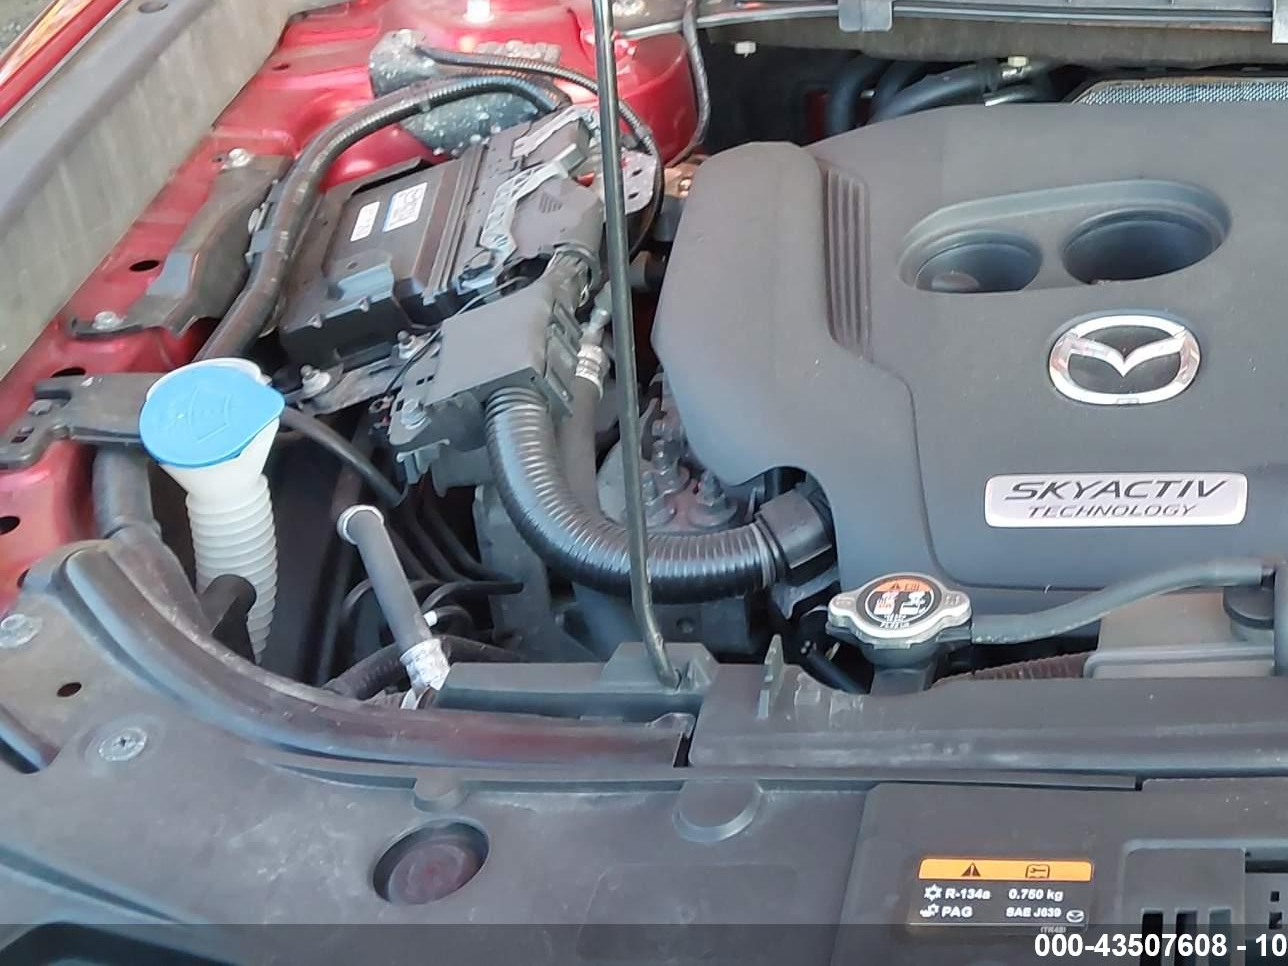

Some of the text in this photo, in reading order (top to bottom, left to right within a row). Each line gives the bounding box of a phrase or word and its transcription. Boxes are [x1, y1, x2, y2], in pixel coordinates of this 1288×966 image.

[1004, 480, 1228, 500] SKYACTIV
[1027, 504, 1197, 518] TECHNOLOGY
[945, 888, 1063, 902] R-134a 0.750 kg
[941, 906, 973, 918] PAG
[1006, 907, 1031, 918] SAE
